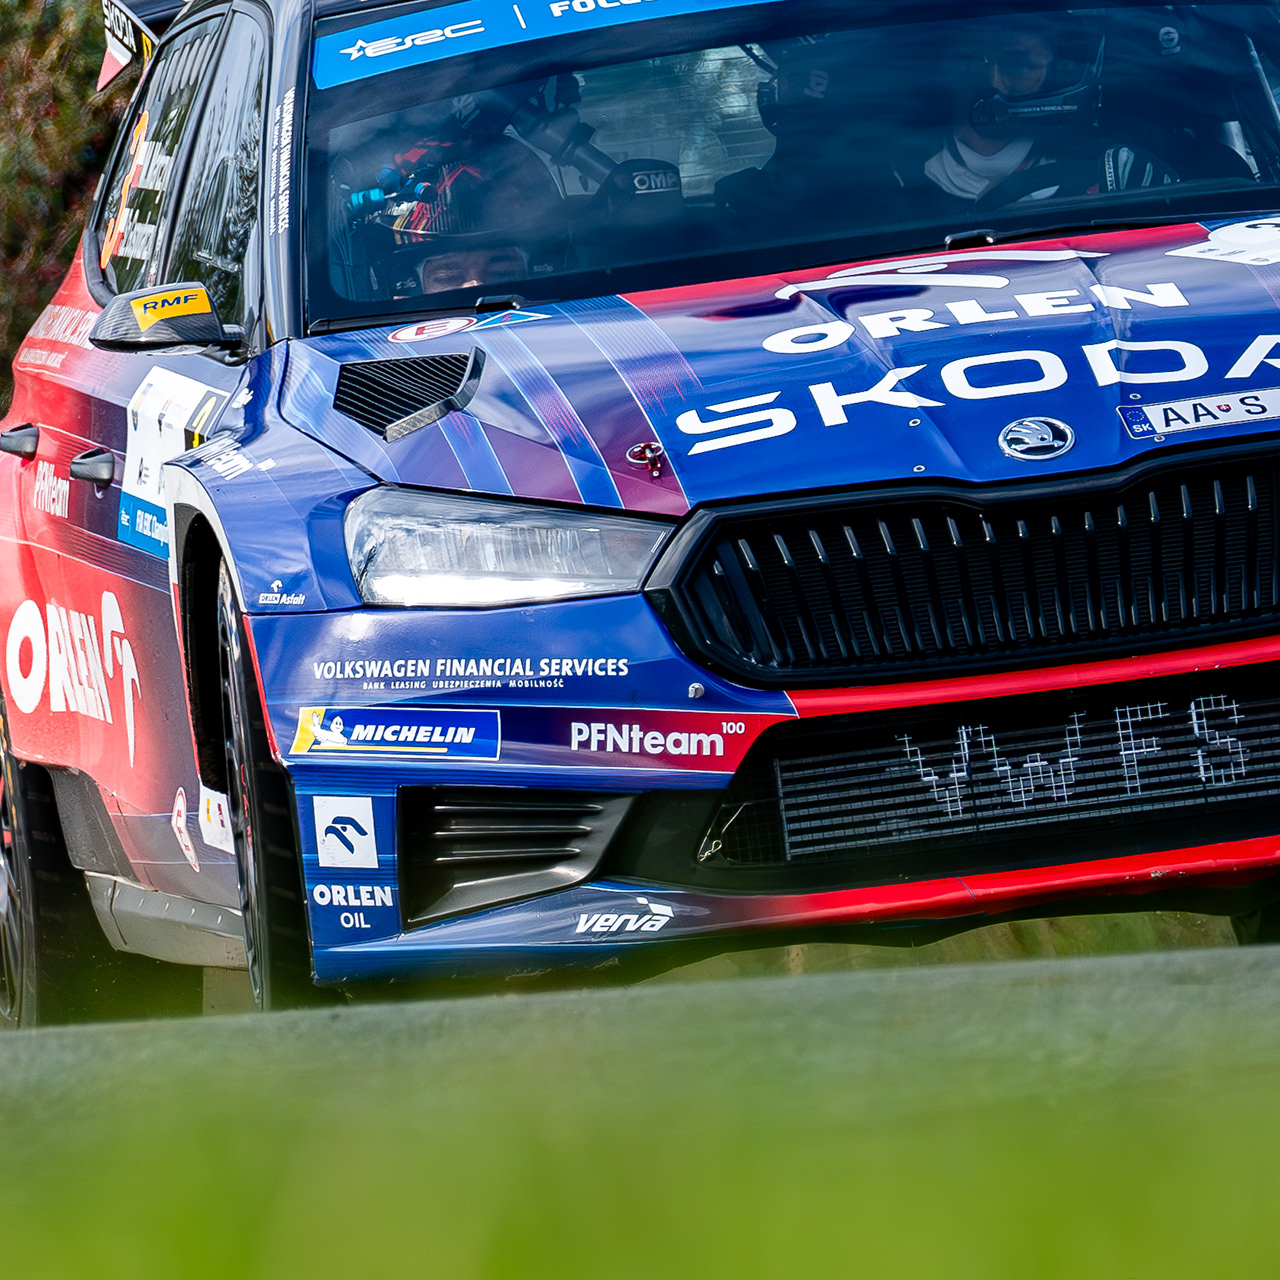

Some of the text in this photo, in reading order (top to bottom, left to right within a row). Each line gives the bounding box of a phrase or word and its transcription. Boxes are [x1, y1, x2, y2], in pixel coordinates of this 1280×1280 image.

[633, 173, 677, 190] OMP
[143, 294, 198, 314] RMF
[762, 282, 1190, 355] ORLEN
[1161, 402, 1219, 428] AA
[1132, 423, 1152, 433] SK
[280, 593, 306, 605] Asfalt
[6, 599, 113, 724] ORLEN
[313, 658, 629, 679] VOLKSWAGEN FINANCIAL SERVICES
[363, 677, 564, 689] BANK LEASING UBEZPIECZENIA MOBILNOŚĆ
[350, 724, 477, 744] MICHELIN
[313, 884, 393, 907] ORLEN
[340, 912, 371, 929] OIL
[575, 907, 672, 933] verva
